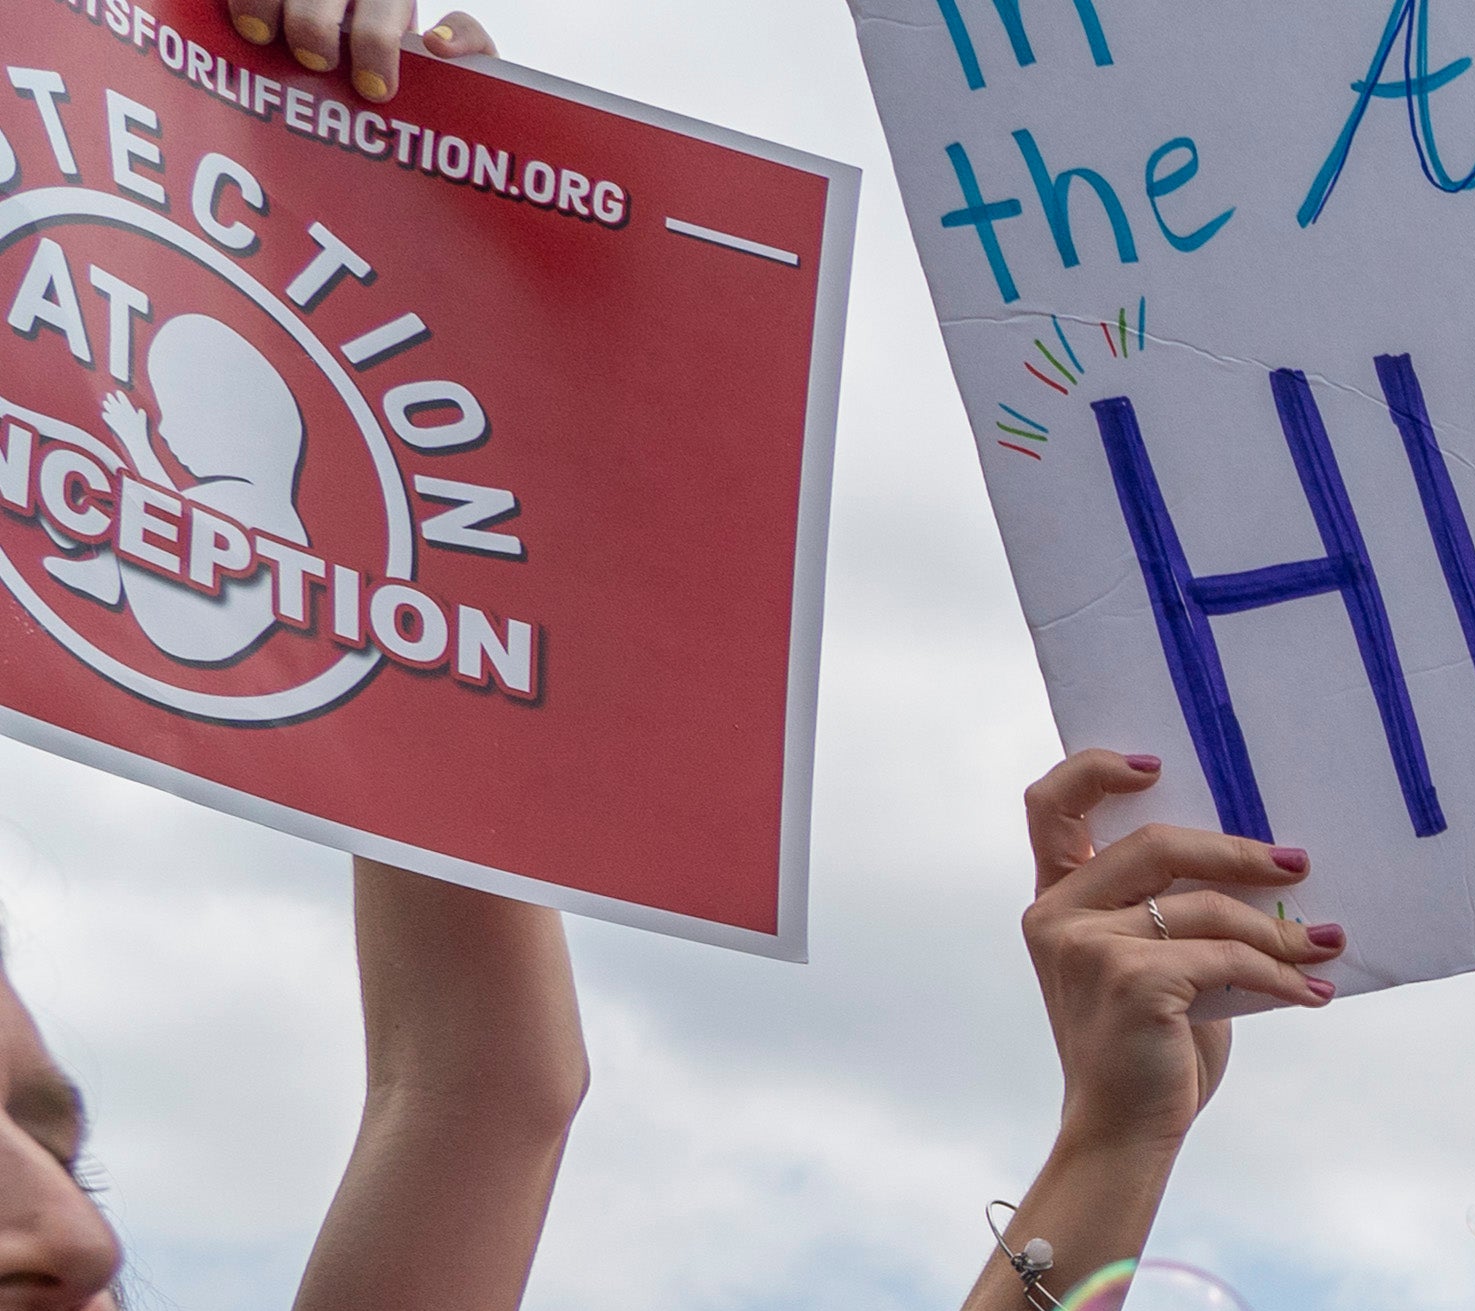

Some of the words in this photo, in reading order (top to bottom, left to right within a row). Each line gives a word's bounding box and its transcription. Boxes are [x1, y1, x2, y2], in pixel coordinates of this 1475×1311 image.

[68, 0, 627, 223] SFORLIFEACTION.ORG
[941, 129, 1235, 304] the
[8, 238, 150, 383] AT
